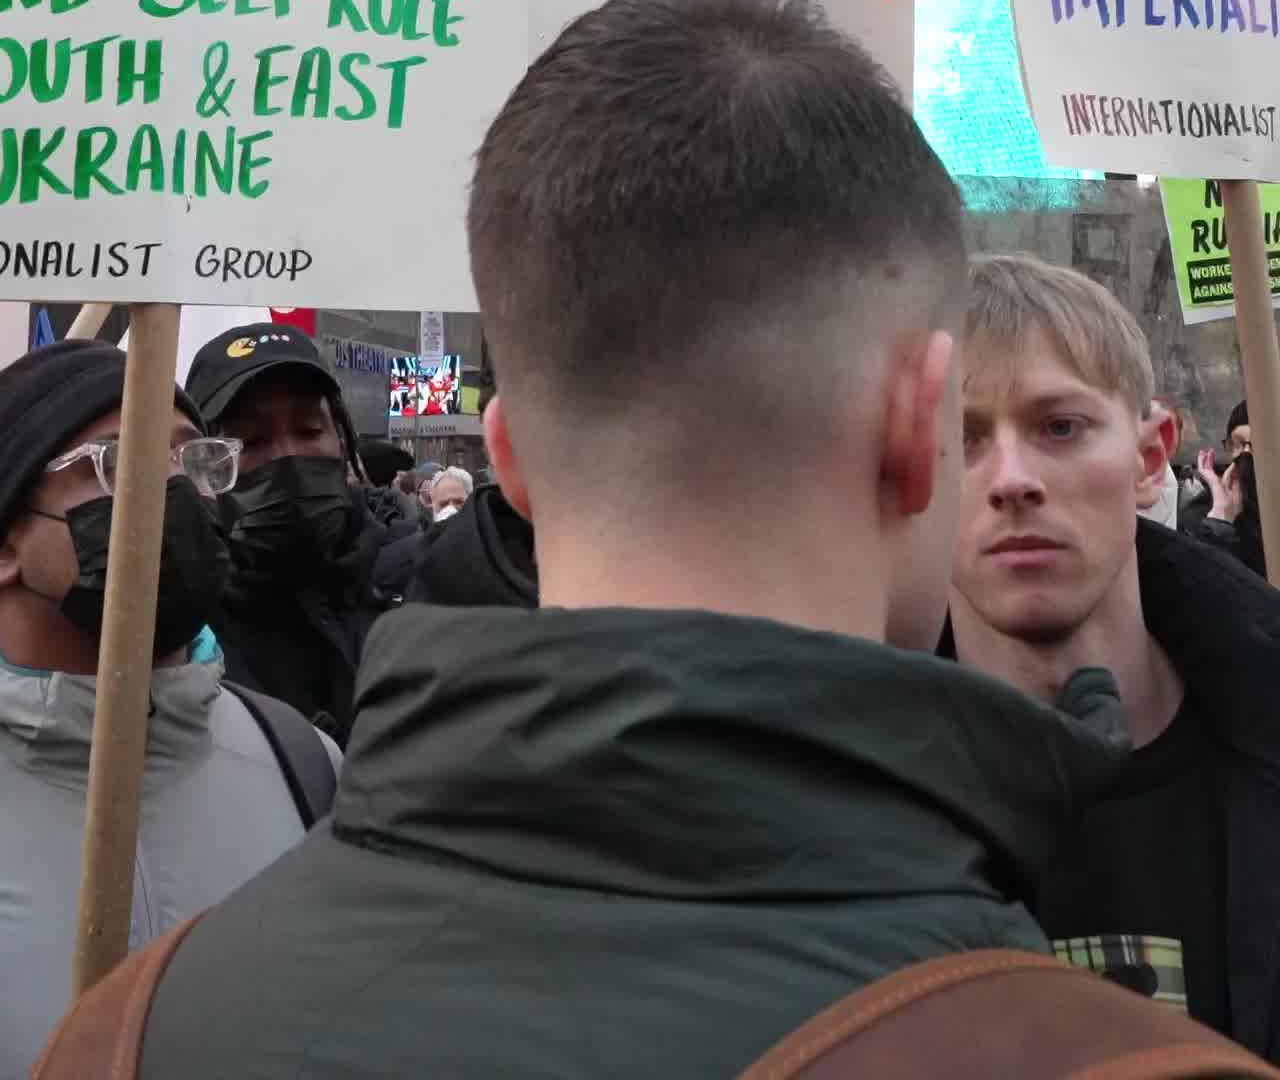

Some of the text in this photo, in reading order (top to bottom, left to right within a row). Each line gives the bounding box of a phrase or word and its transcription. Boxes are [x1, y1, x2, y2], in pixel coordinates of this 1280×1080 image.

[195, 40, 237, 119] &
[254, 43, 428, 129] EAST
[1061, 92, 1276, 144] INTERNATIONALIST
[195, 242, 314, 282] GROUP
